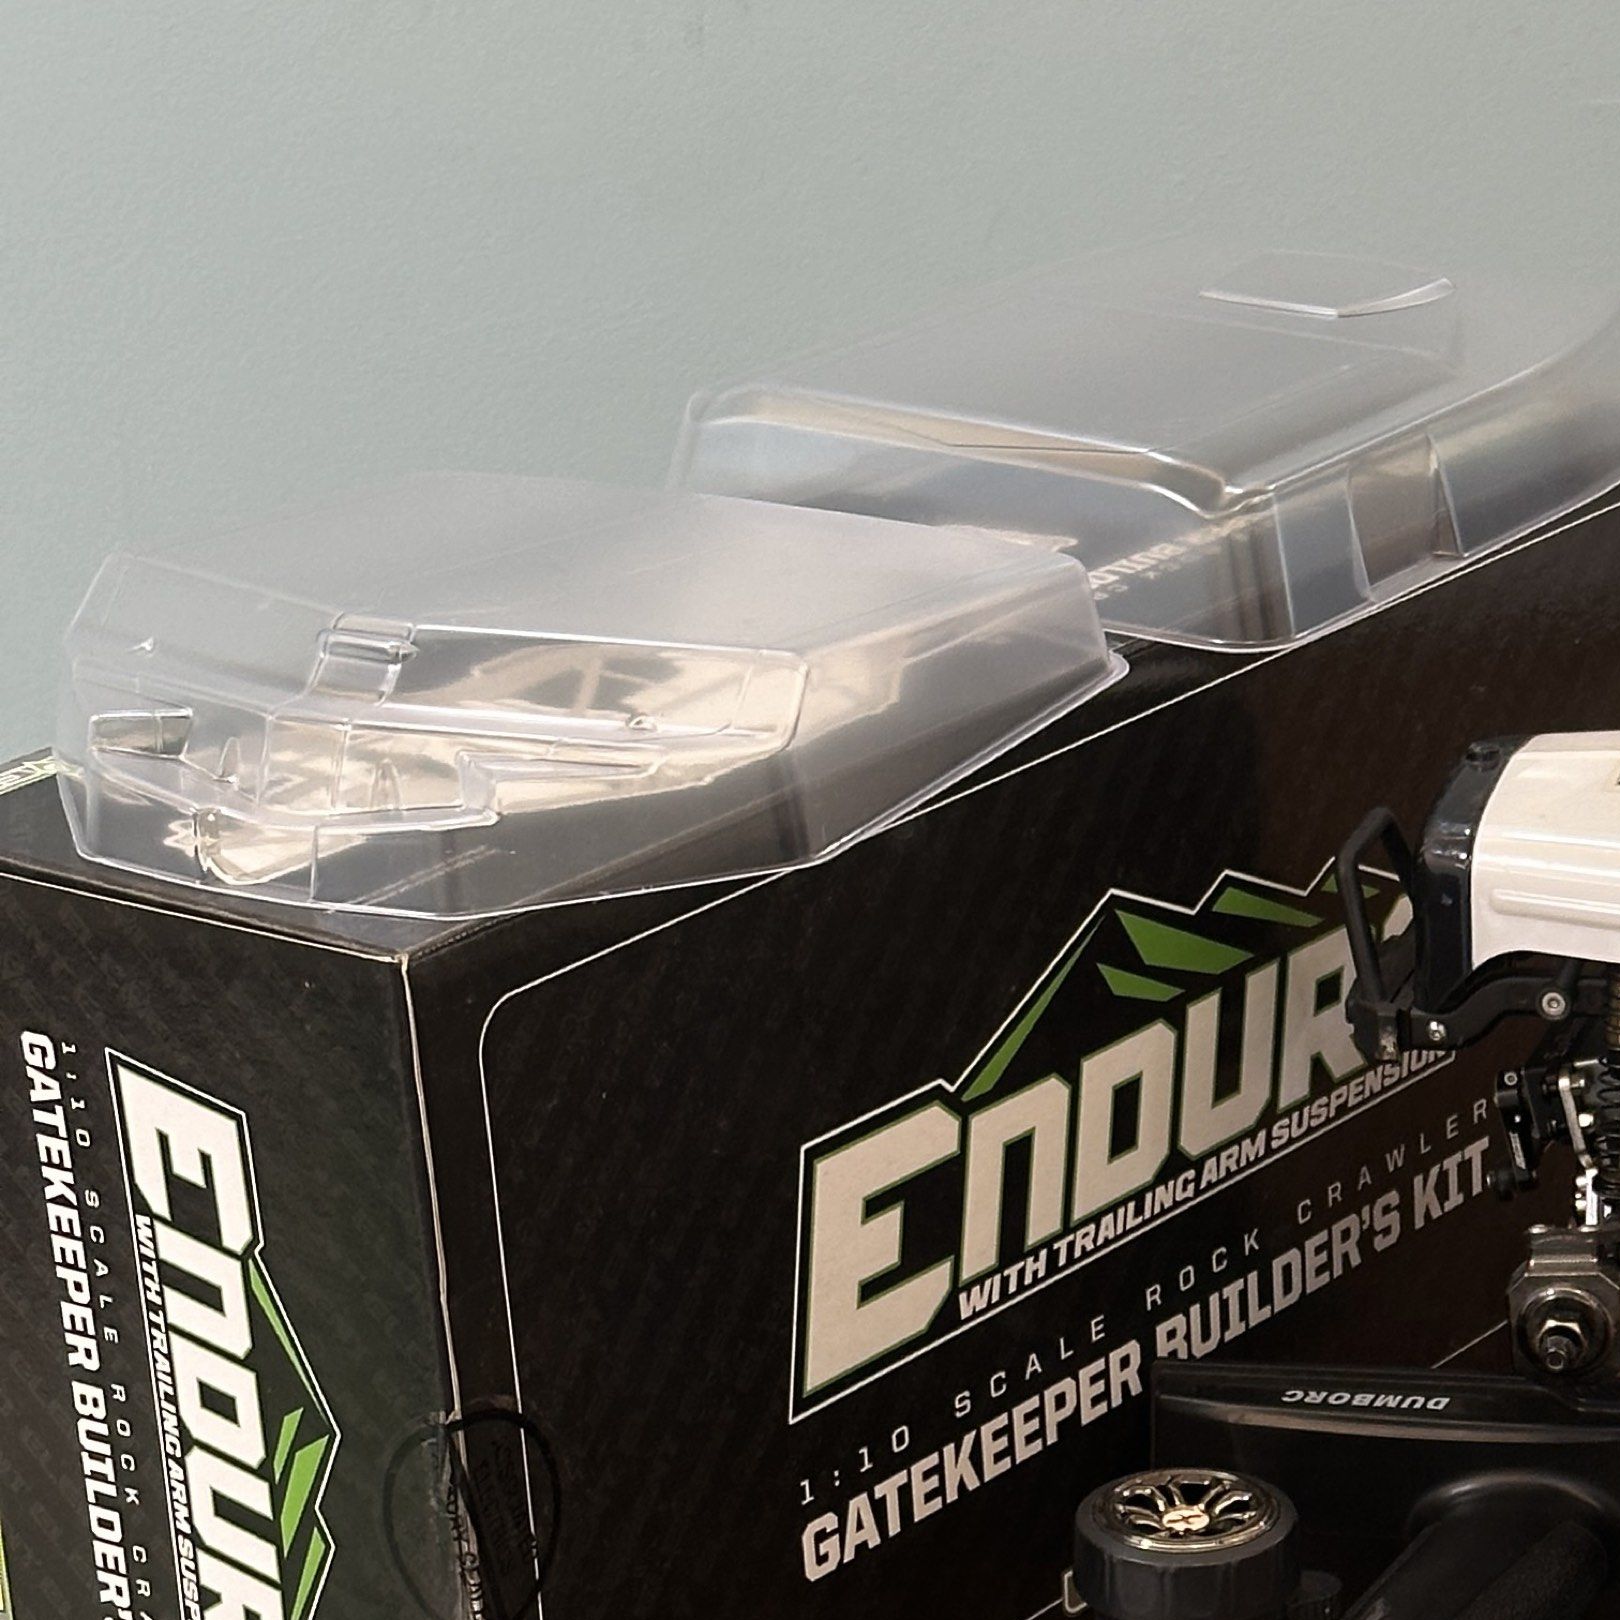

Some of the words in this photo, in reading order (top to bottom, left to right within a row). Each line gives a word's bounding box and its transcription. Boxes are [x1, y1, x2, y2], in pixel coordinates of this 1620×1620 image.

[21, 1031, 100, 1371] GATEKEEPER
[61, 1041, 90, 1147] 1:10
[85, 1189, 118, 1344] SCALE
[111, 1384, 139, 1506] ROCK
[135, 1214, 162, 1304] WITH
[803, 895, 1413, 1397] ENDUR
[959, 1247, 1047, 1319] WITH
[1053, 1169, 1196, 1268] TRAILING
[1200, 1131, 1266, 1188] ARM
[147, 1310, 183, 1457] TRAILING
[801, 1426, 909, 1505] 1:10
[954, 1315, 1105, 1418] SCALE
[1145, 1228, 1260, 1311] ROCK
[1297, 1098, 1487, 1225] CRAWLER
[802, 1339, 1143, 1582] GATEKEEPER
[1156, 1190, 1400, 1360] BUILDER'S
[1414, 1136, 1489, 1230] KIT
[1281, 1390, 1450, 1410] DUMBORC
[166, 1459, 191, 1534] ARM
